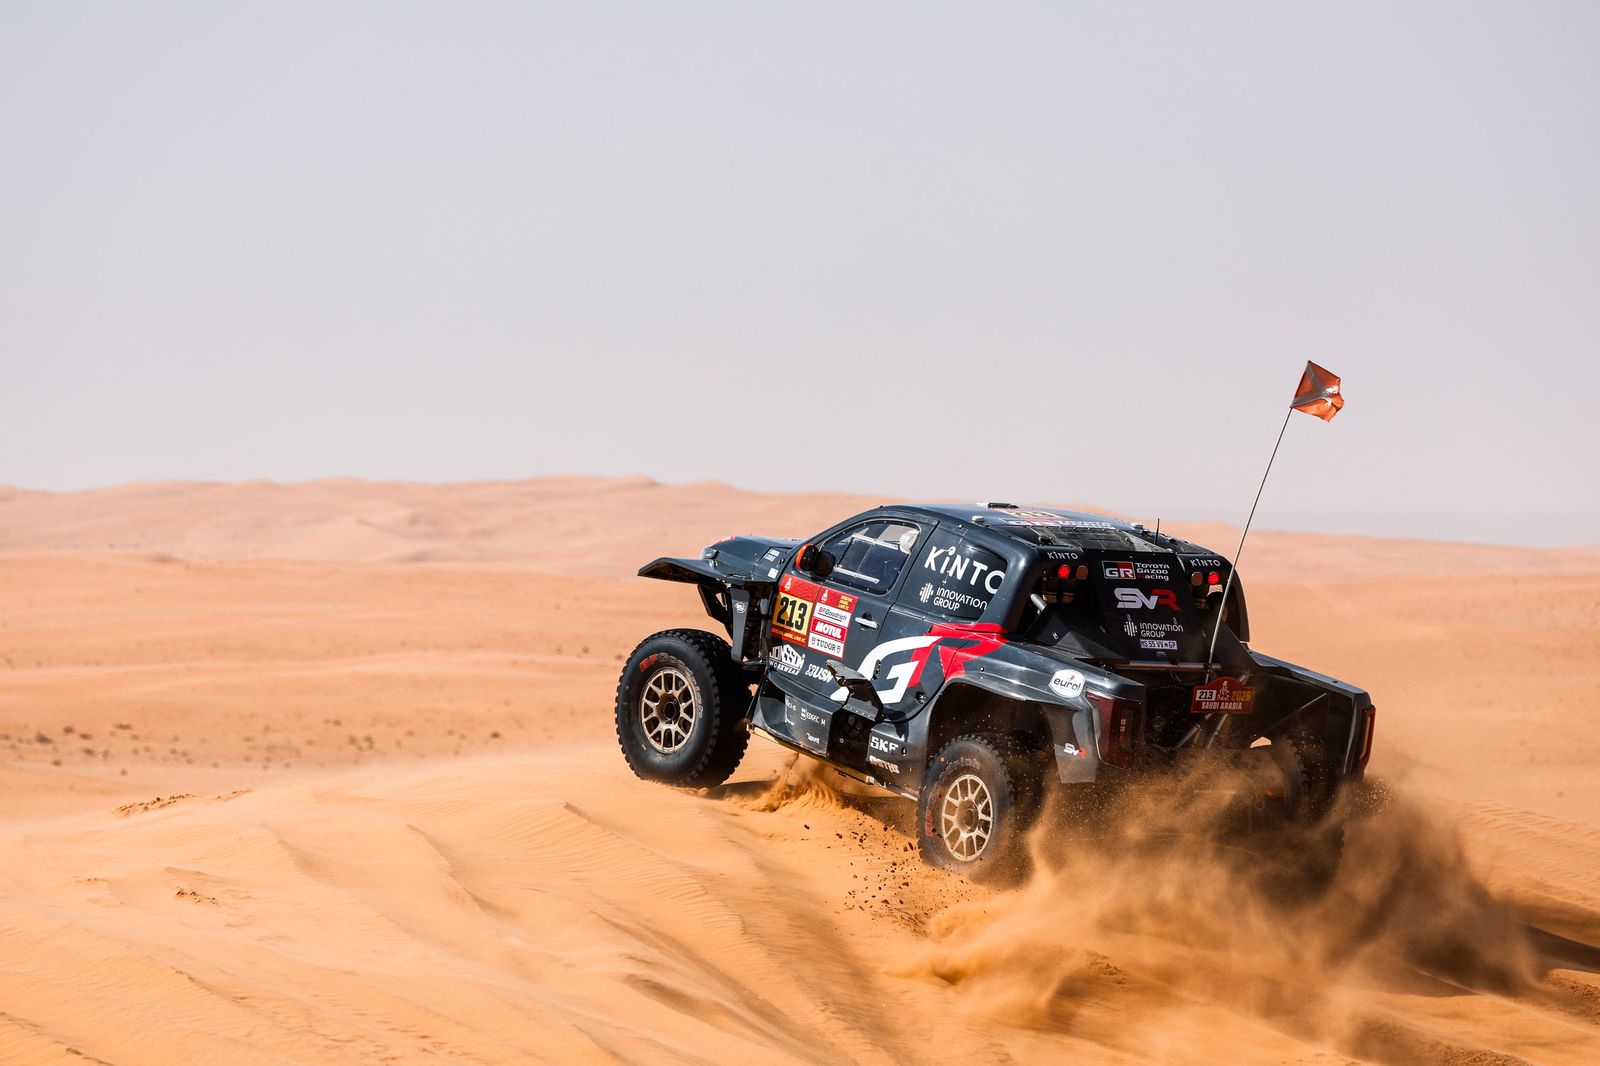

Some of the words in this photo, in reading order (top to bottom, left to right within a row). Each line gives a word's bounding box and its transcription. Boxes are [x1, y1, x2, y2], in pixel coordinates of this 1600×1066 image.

[1105, 567, 1134, 578] GR
[933, 596, 960, 611] GROUP
[777, 596, 808, 631] 213
[818, 606, 847, 621] BFGoodrich
[815, 622, 842, 640] MOTUL
[1140, 629, 1165, 638] GROUP
[816, 638, 836, 653] TUDOR
[769, 660, 800, 676] WORKWEAR
[1198, 691, 1214, 700] 213
[1231, 690, 1252, 702] 2026
[1201, 701, 1219, 710] SAUDI
[1220, 701, 1242, 710] ARABIA
[870, 736, 899, 753] SKF
